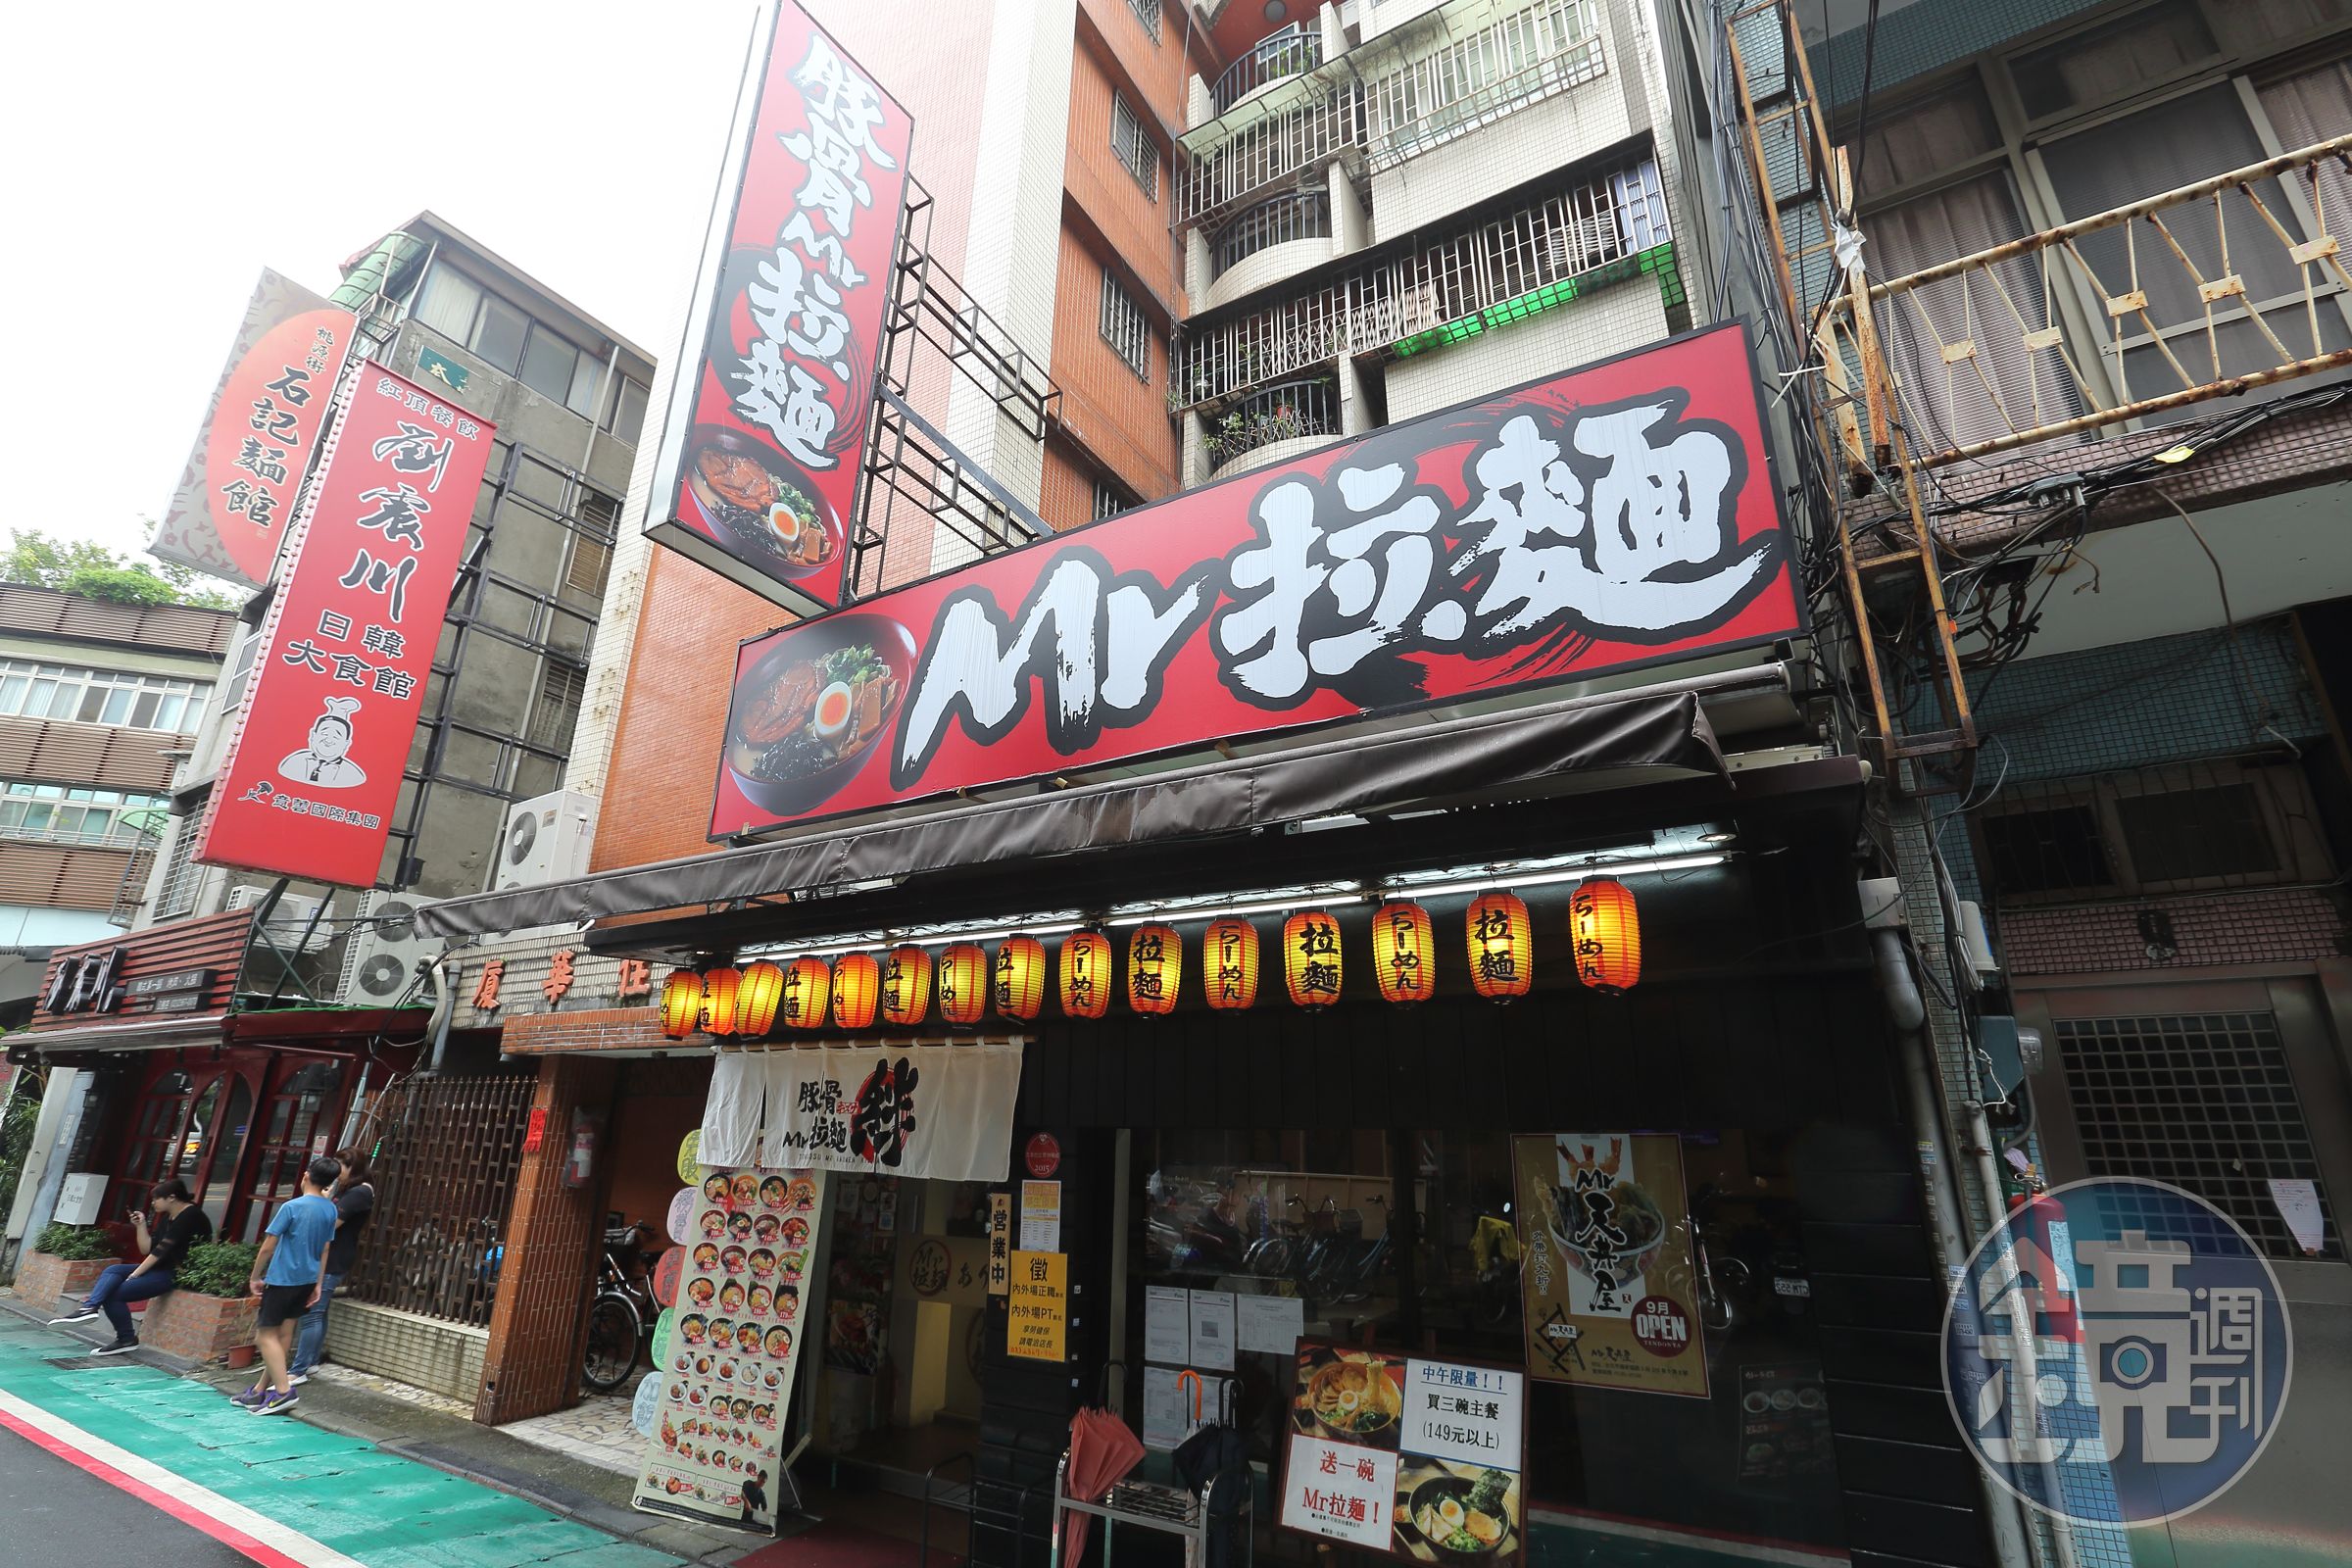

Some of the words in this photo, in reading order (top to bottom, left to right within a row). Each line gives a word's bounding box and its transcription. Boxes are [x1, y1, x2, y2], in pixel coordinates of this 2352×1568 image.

[305, 325, 335, 375] 桃源街
[376, 378, 481, 442] 紅頂餐飲
[220, 364, 313, 529] 石記麵館
[899, 403, 1771, 772] Mr拉麵
[282, 639, 416, 701] 大食館
[1132, 934, 1165, 1001] 拉麵
[1217, 925, 1244, 1001] らーめん
[1299, 922, 1339, 995] 拉麵
[1391, 911, 1421, 991] らーめん
[1474, 909, 1516, 983] 拉麵
[1574, 895, 1603, 979] らーめん
[1069, 939, 1093, 1006] らーめん
[799, 1079, 842, 1114] 豚骨
[1575, 1168, 1615, 1192] Mr
[1030, 1257, 1049, 1282] 徵
[1635, 1313, 1687, 1342] OPEN
[1645, 1300, 1670, 1314] 9月
[1423, 1421, 1500, 1450] (149元以上)
[1427, 1393, 1499, 1421] 買三碗主餐
[1319, 1449, 1376, 1483] 送一碗
